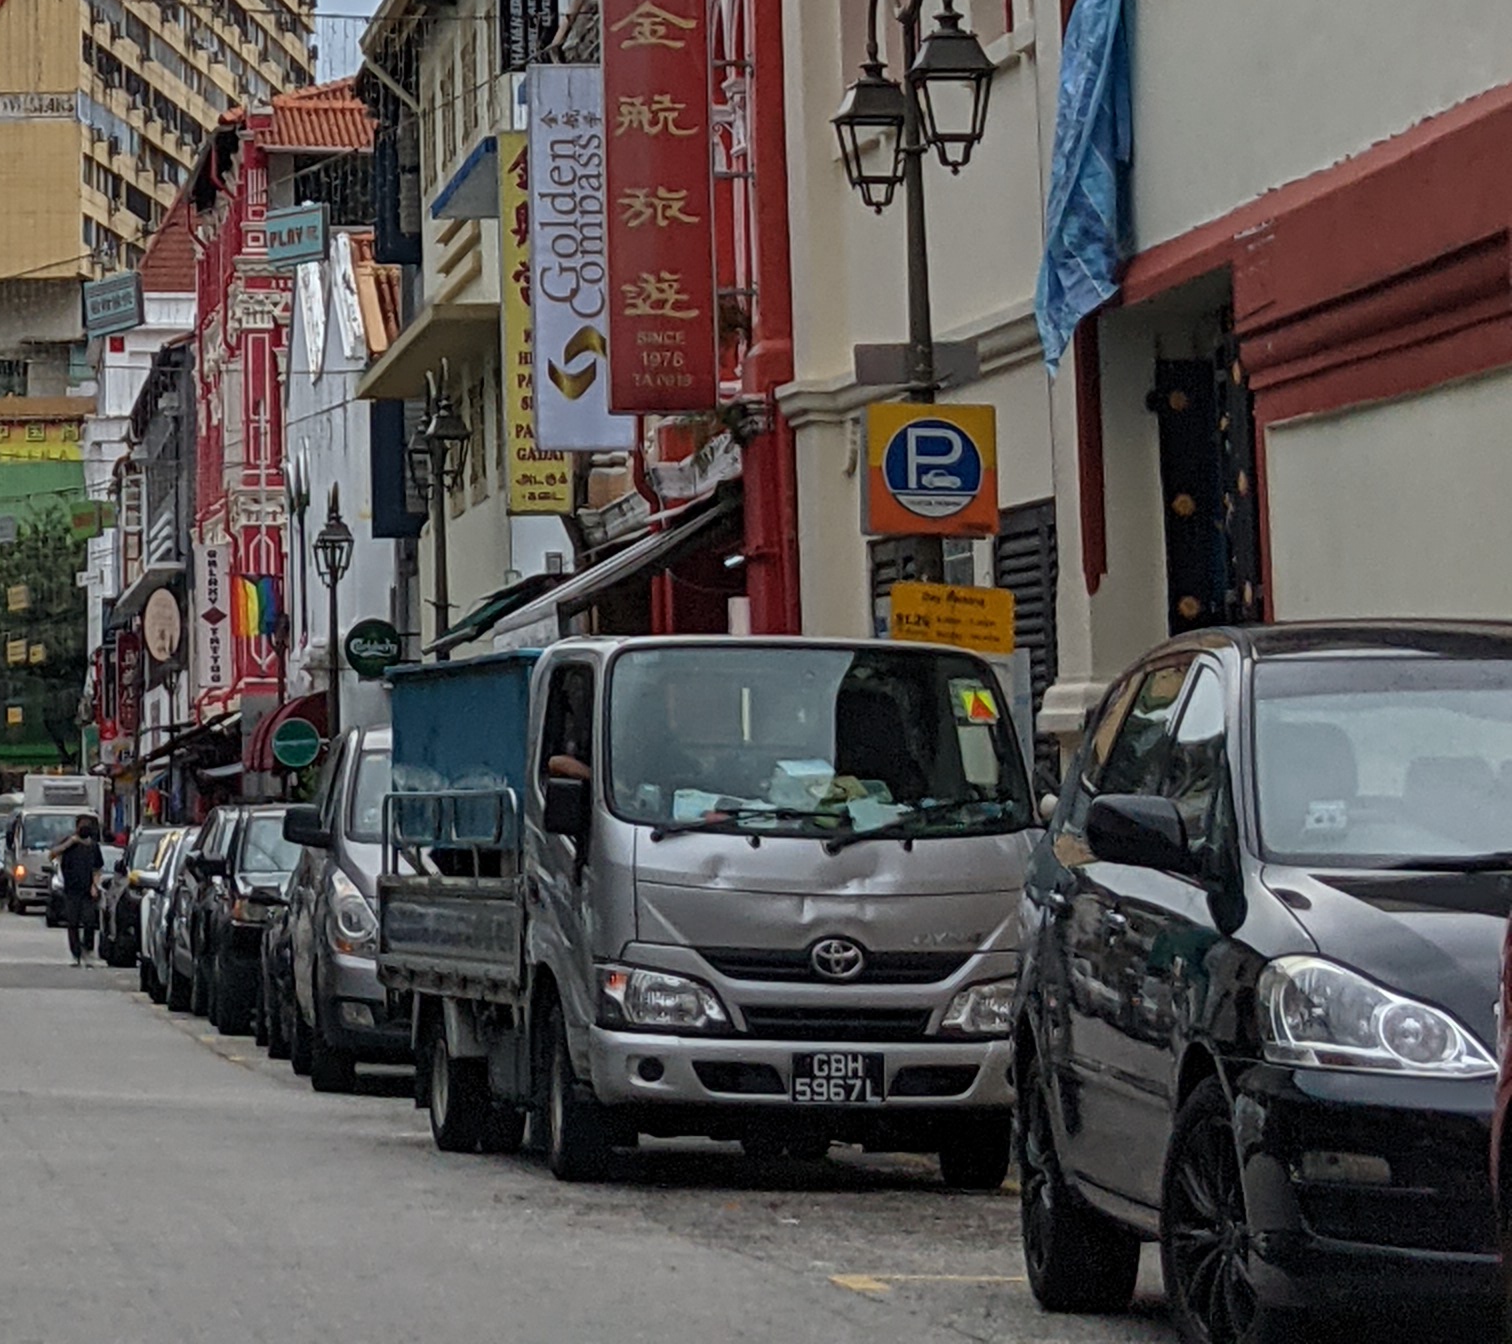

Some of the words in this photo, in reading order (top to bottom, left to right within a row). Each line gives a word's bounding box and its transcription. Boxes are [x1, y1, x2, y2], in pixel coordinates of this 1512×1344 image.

[538, 136, 582, 304] Golden
[569, 133, 606, 320] Compass
[907, 427, 963, 489] P
[207, 550, 218, 605] GALAXY
[210, 628, 221, 683] TATTOO
[795, 1077, 883, 1102] 5967L
[813, 1054, 864, 1077] GBH
